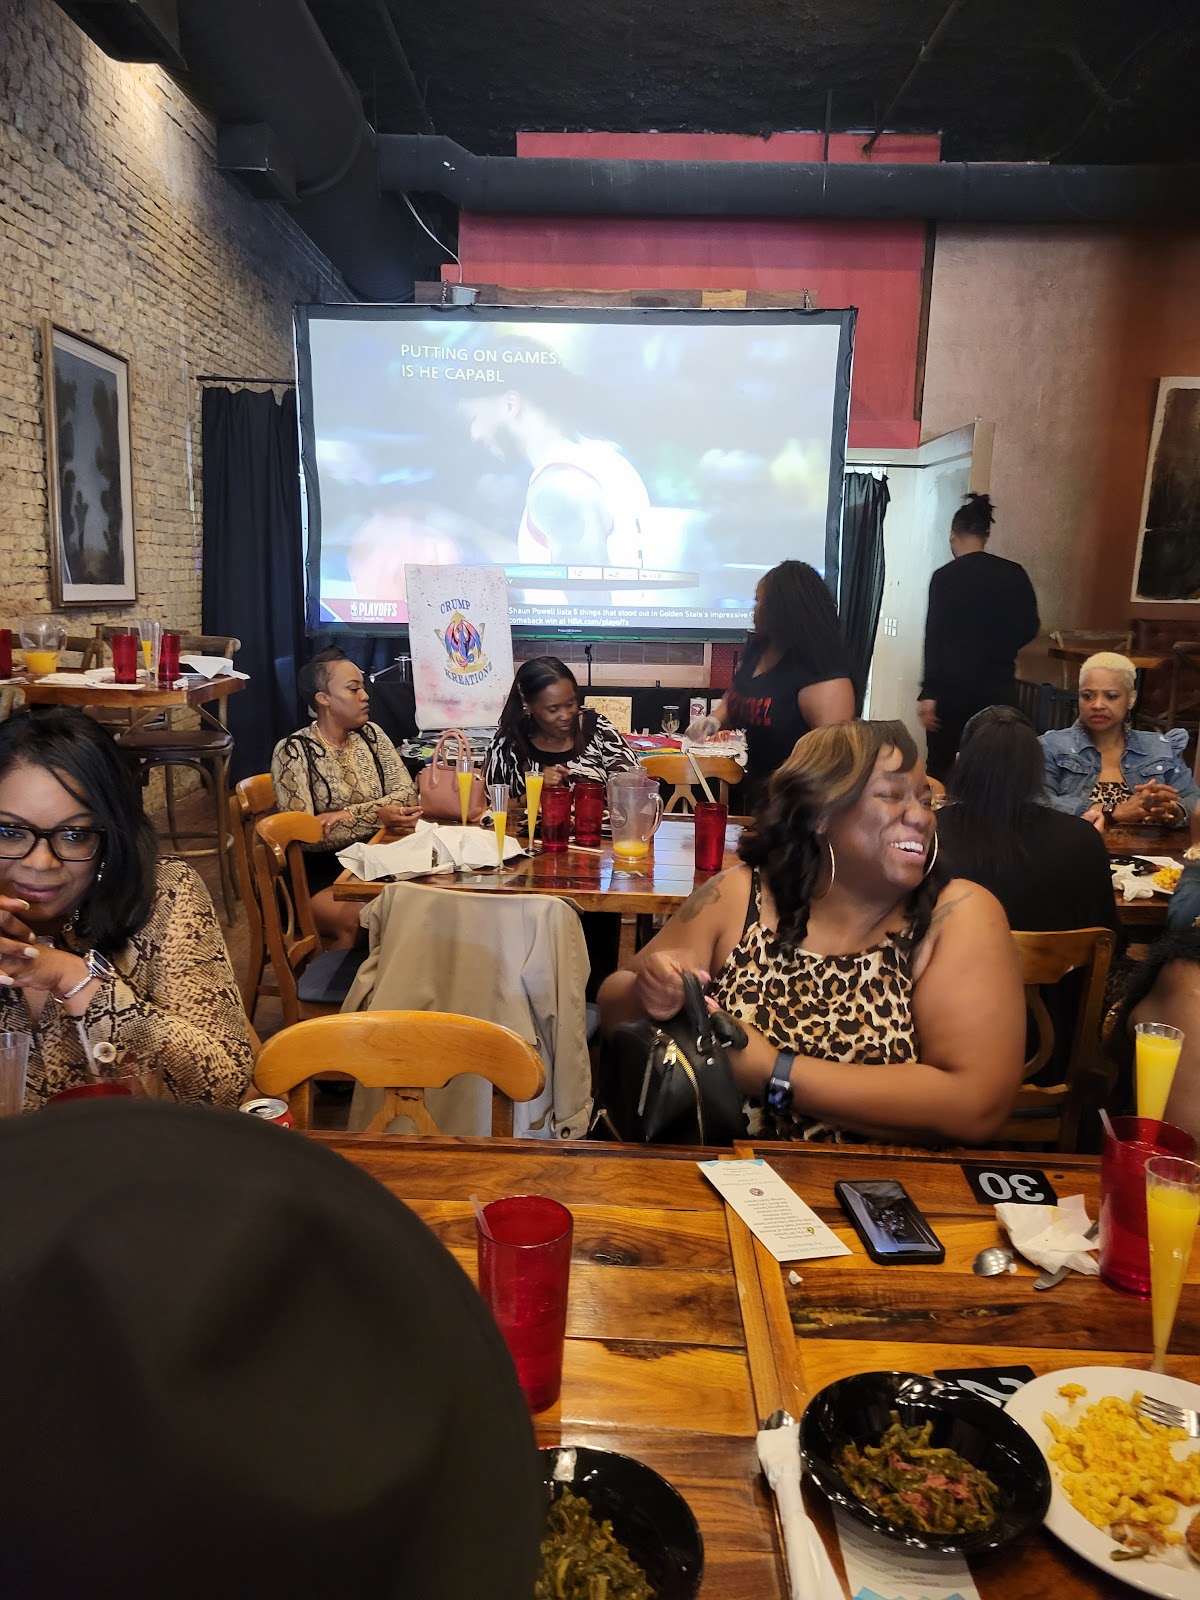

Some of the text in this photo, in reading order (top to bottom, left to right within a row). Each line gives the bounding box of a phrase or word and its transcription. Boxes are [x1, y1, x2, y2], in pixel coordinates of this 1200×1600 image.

[400, 344, 561, 365] PUTTING ON GAMES.
[402, 364, 504, 383] IS HE CAPABL
[358, 601, 398, 617] PLAYOFFS
[508, 606, 530, 615] Shaun
[532, 607, 555, 616] Powell
[580, 608, 601, 617] things
[602, 608, 617, 617] that
[618, 608, 637, 617] stood
[638, 609, 650, 617] out
[659, 609, 684, 618] Golden
[685, 610, 709, 618] State's
[710, 610, 748, 620] impressive
[978, 1172, 1045, 1202] 30
